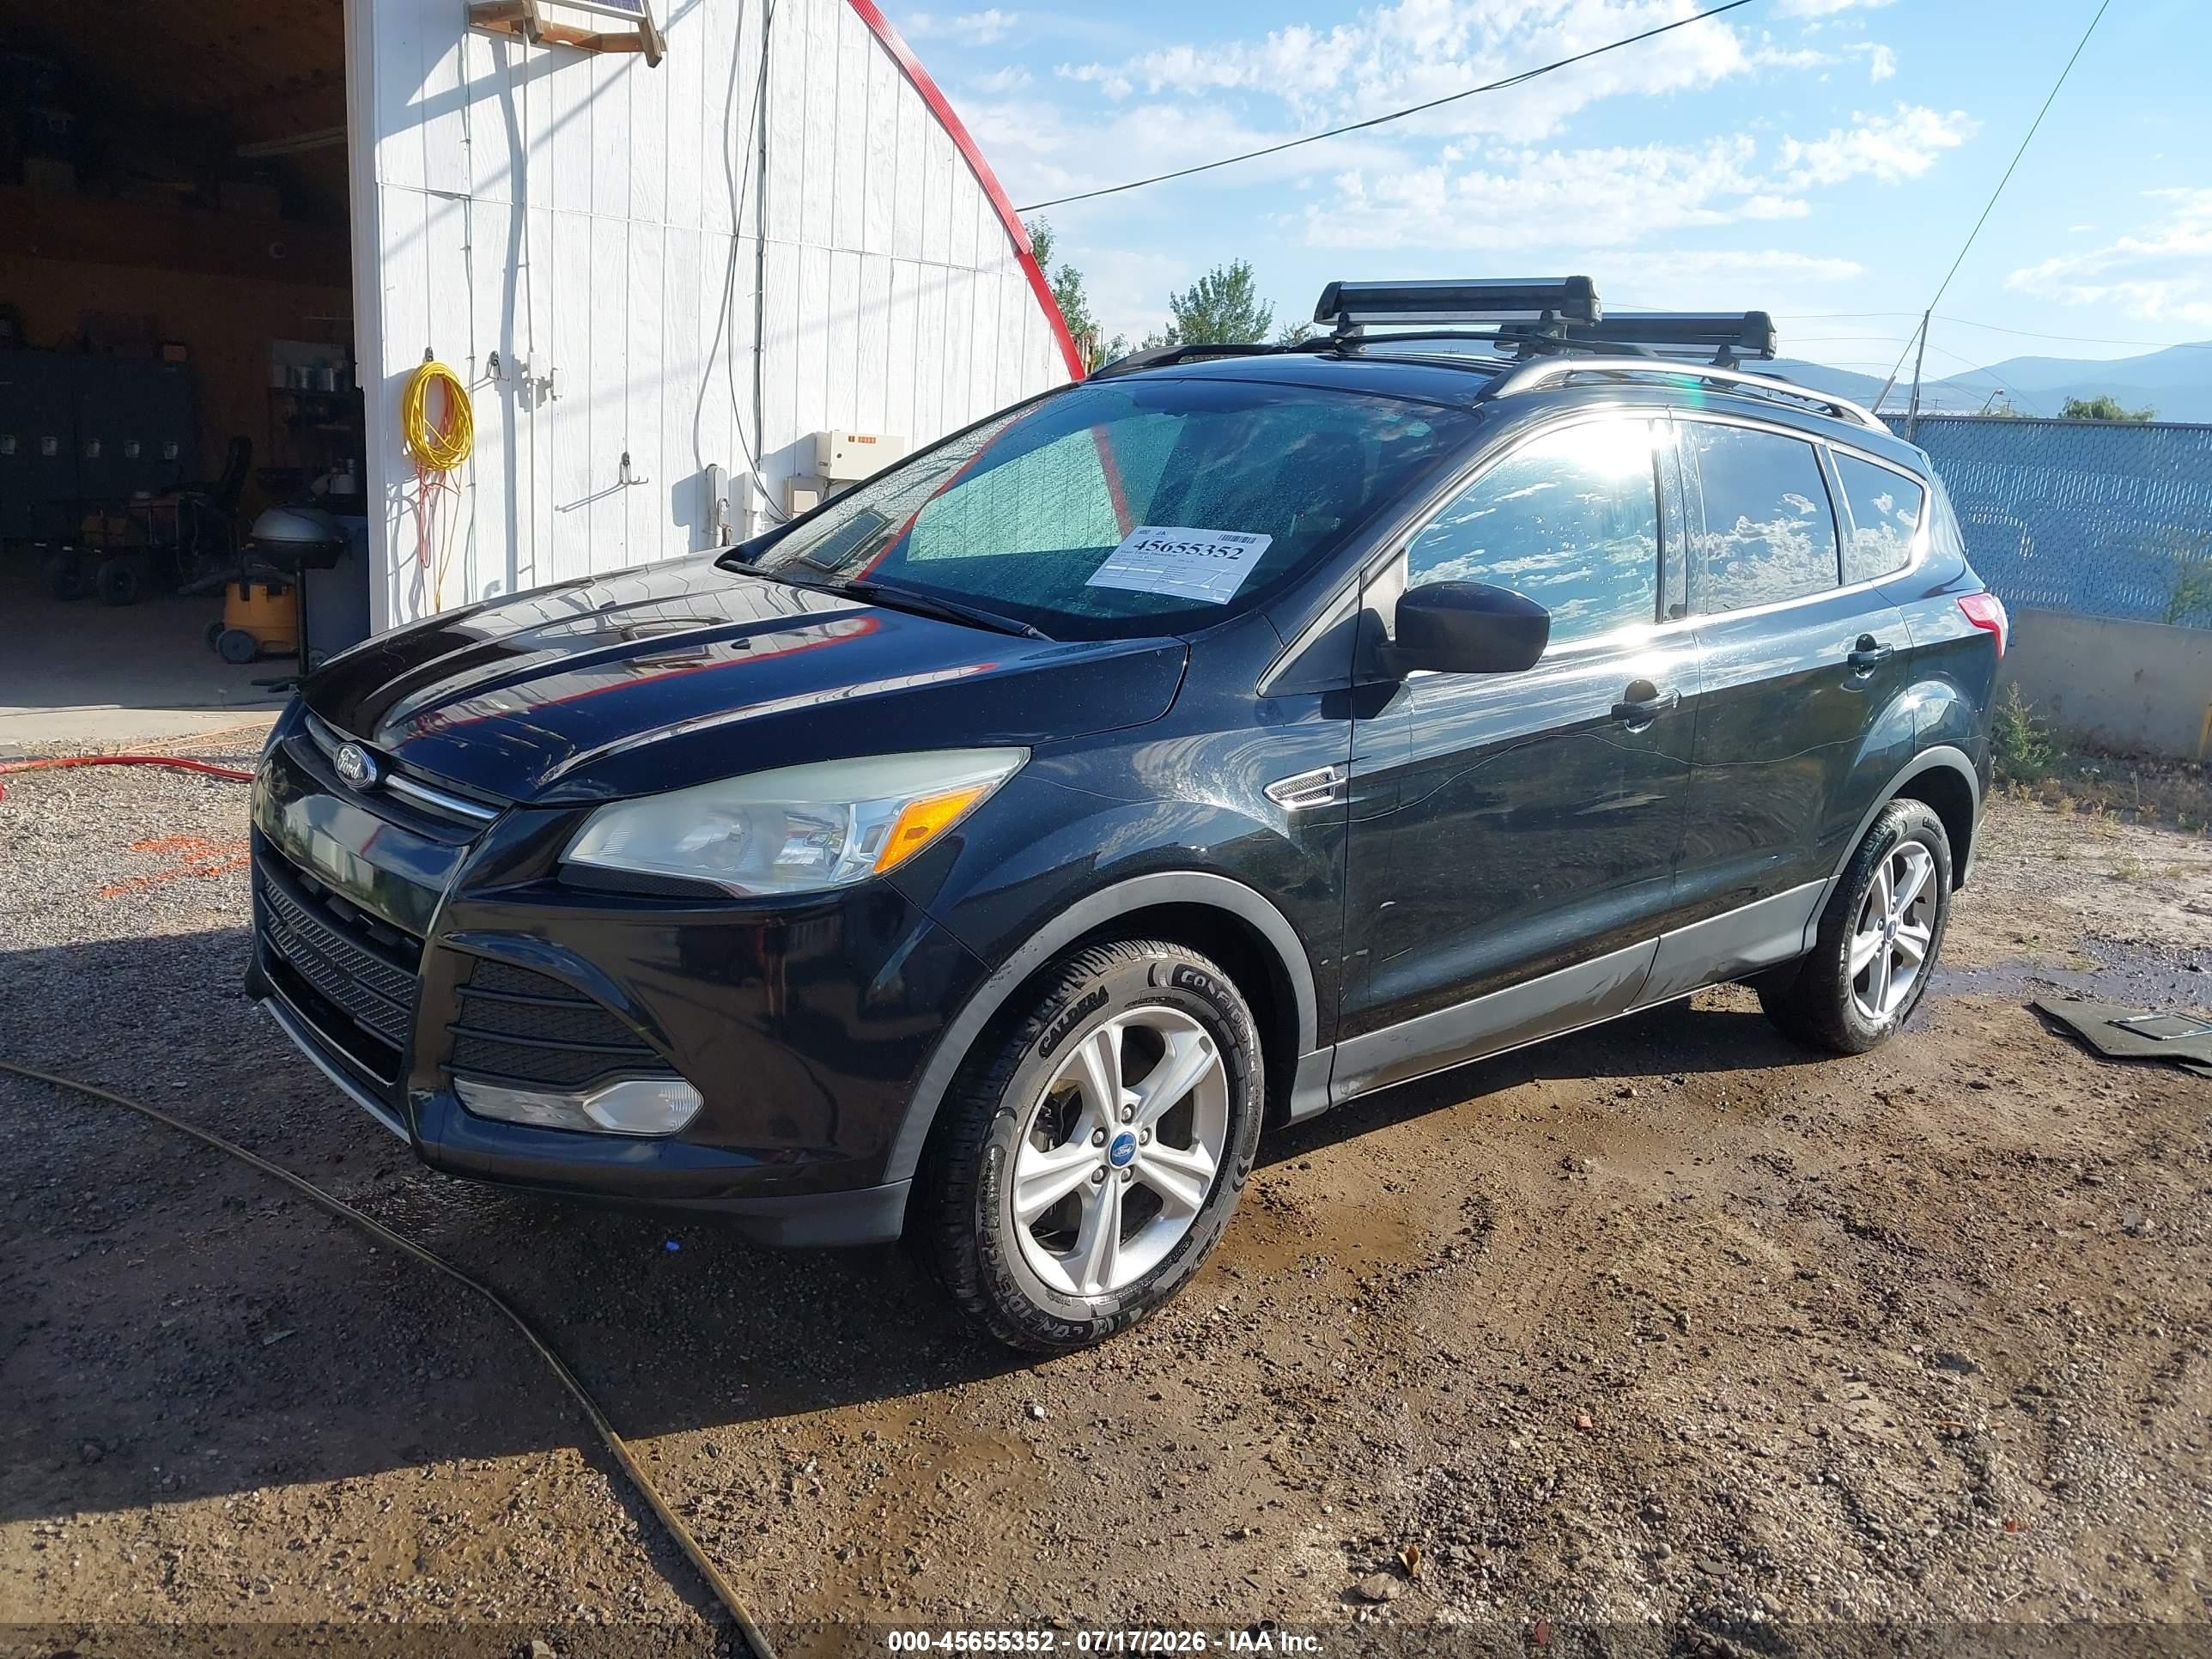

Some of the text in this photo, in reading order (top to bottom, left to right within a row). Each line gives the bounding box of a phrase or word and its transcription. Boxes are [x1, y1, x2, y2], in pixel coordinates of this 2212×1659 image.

[1133, 539, 1245, 560] 45655352
[339, 748, 362, 779] Ford
[1115, 1145, 1133, 1156] Ford
